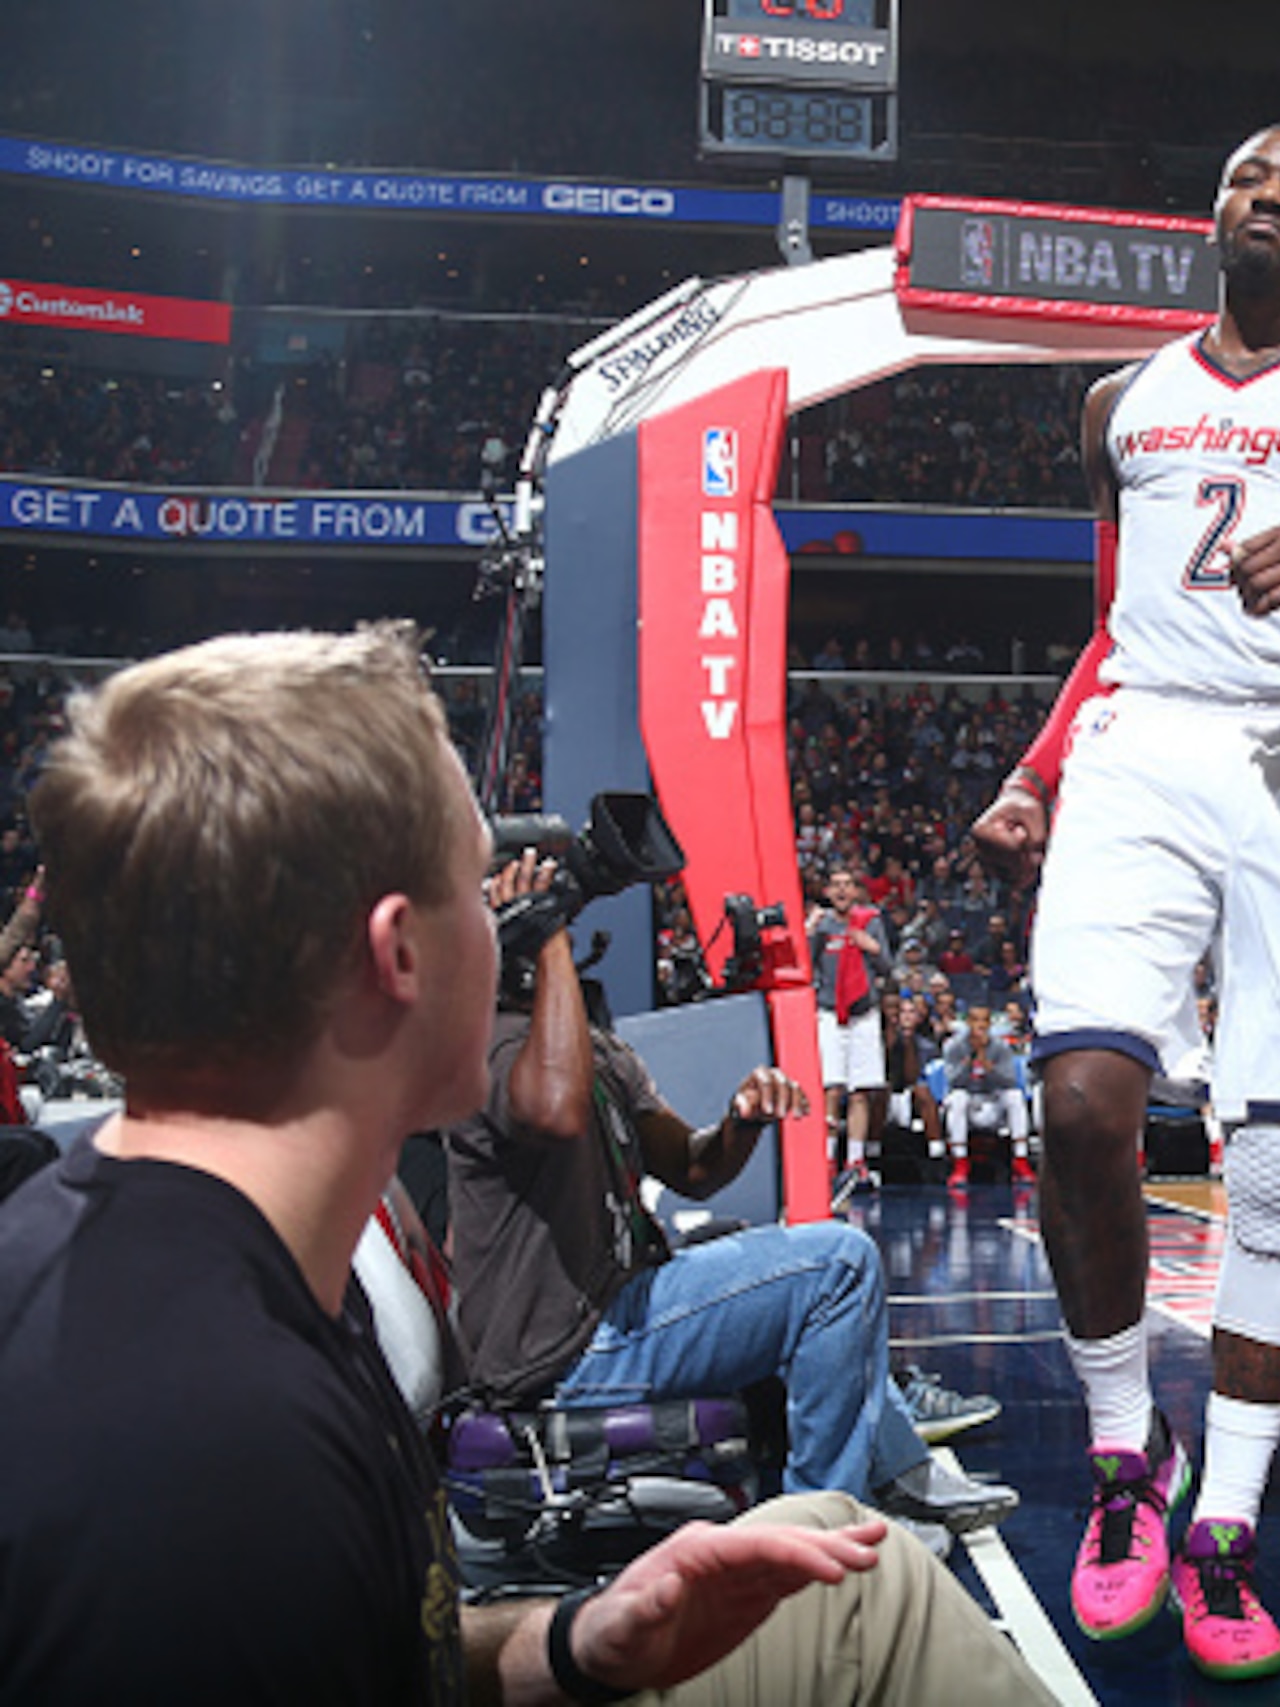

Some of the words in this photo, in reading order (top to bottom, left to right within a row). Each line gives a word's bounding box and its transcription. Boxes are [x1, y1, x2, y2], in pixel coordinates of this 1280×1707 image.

[762, 37, 885, 66] TISSOT
[26, 145, 114, 178] SHOOT
[123, 160, 174, 183] FOR
[295, 176, 341, 199] GET
[349, 178, 367, 199] A
[374, 181, 453, 204] QUOTE
[460, 185, 528, 206] FROM
[543, 184, 674, 214] GEICO
[1019, 231, 1121, 291] NBA
[1130, 244, 1195, 295] TV
[598, 296, 721, 393] SPALDING
[10, 488, 101, 528] GET
[111, 498, 144, 531] A
[157, 498, 299, 536] QUOTE
[311, 502, 426, 537] FROM
[1181, 474, 1246, 591] 2
[700, 511, 738, 638] NBA
[700, 656, 738, 739] TV
